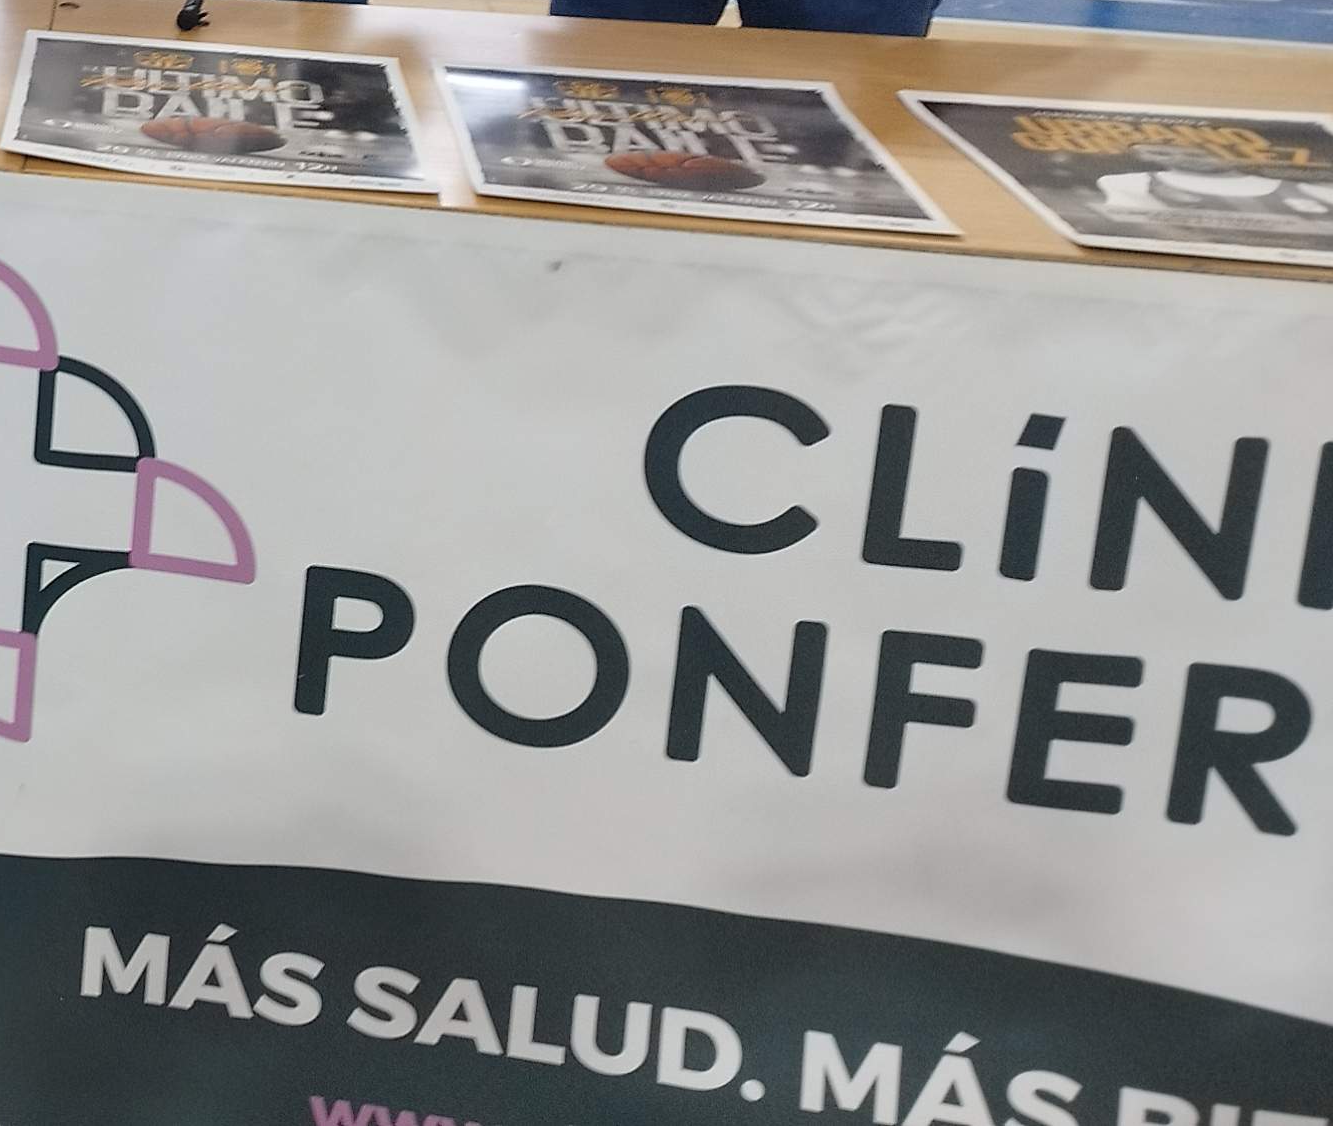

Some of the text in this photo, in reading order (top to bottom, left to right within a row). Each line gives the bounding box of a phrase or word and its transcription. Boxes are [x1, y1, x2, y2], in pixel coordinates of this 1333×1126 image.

[293, 563, 1315, 838] PONFER
[80, 925, 323, 1026] MÁS
[347, 963, 767, 1103] SALUD.
